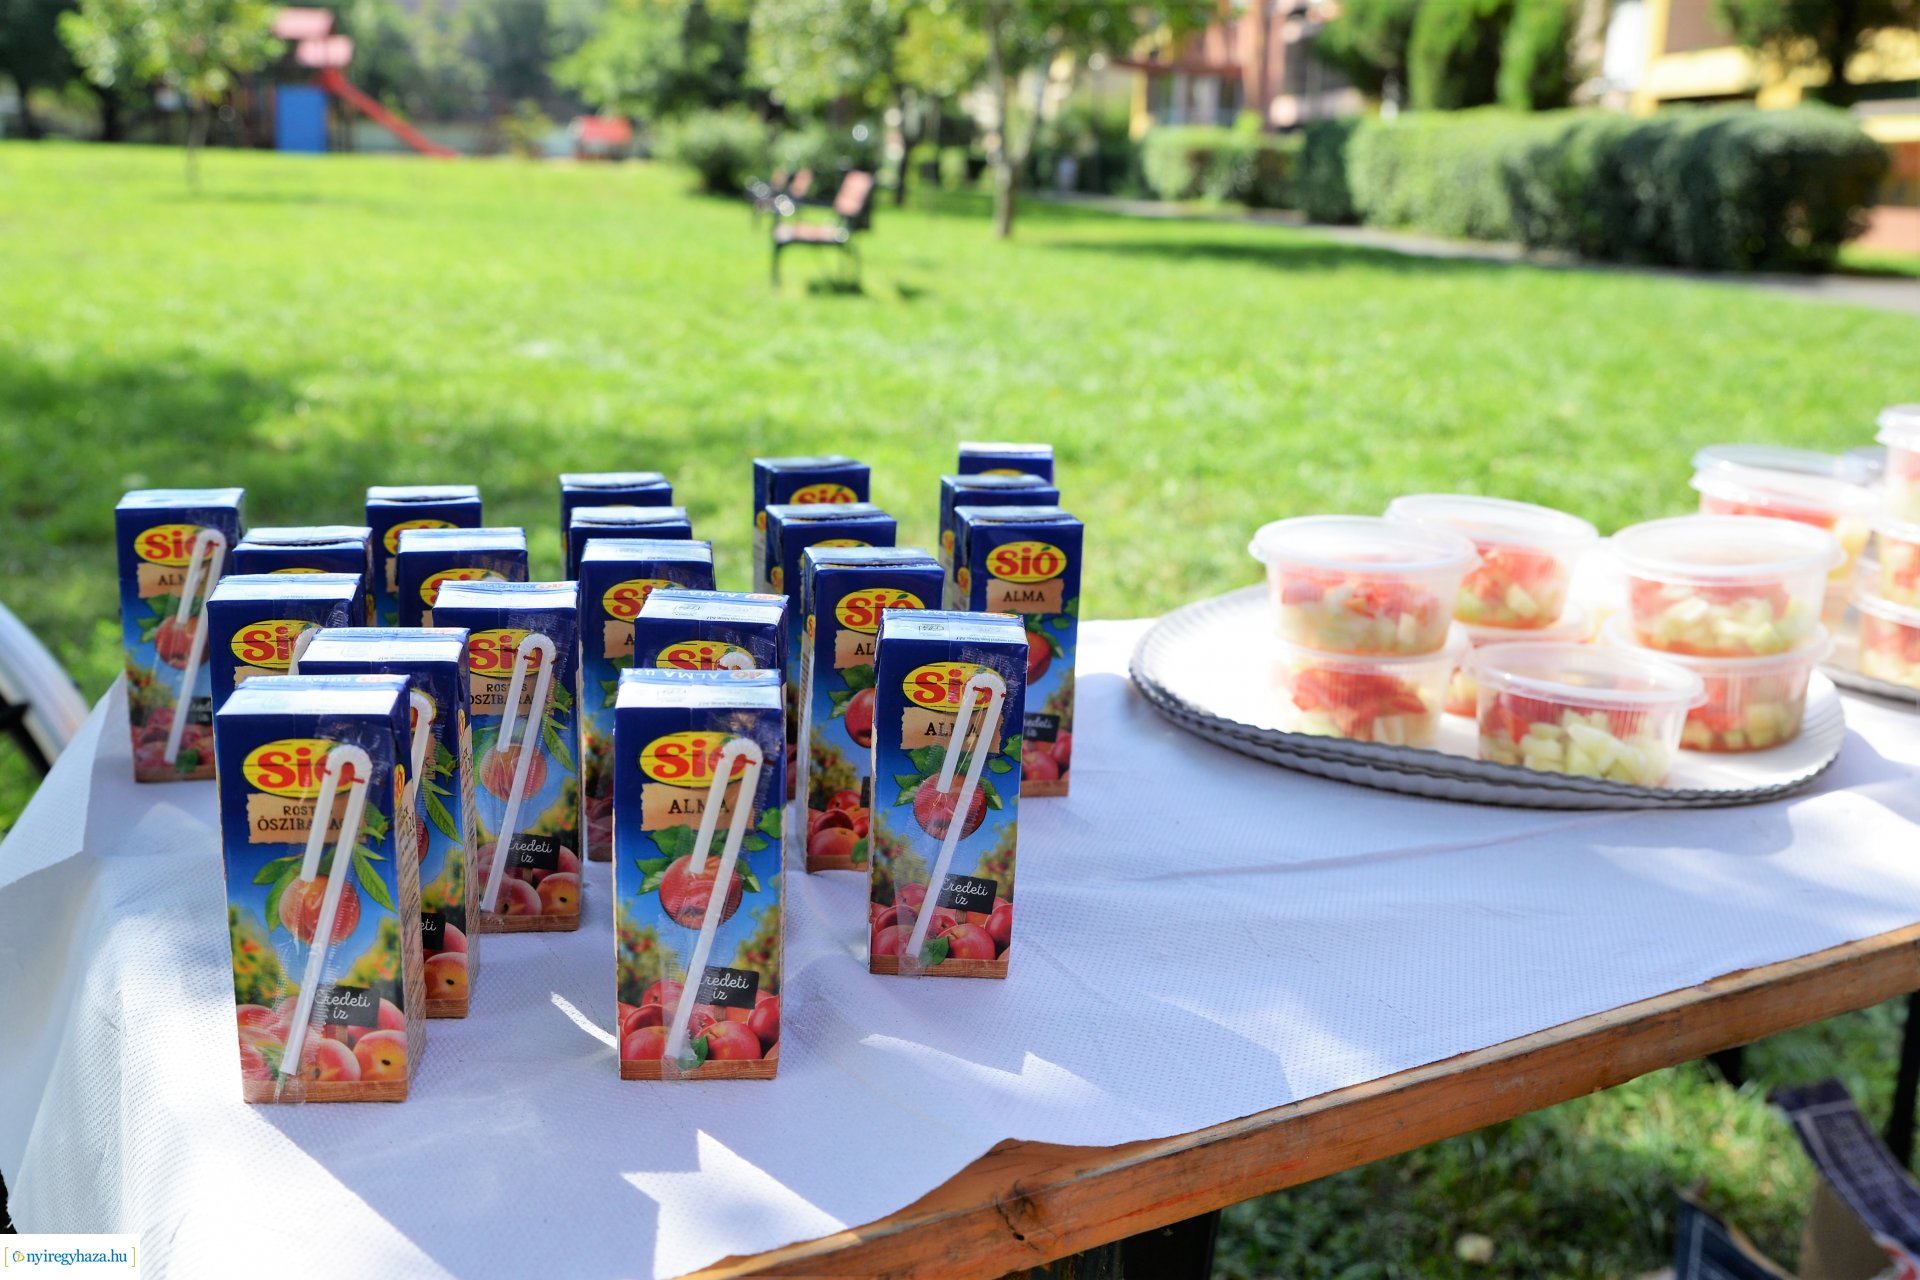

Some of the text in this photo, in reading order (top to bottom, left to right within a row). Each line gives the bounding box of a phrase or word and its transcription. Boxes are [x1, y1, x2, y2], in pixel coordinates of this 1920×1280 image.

[994, 546, 1059, 576] Sió
[1003, 591, 1045, 602] ALMA
[242, 626, 301, 661] Si
[854, 643, 876, 655] AL
[487, 683, 528, 693] ROSS
[283, 805, 333, 816] ROST
[700, 973, 750, 989] redeti
